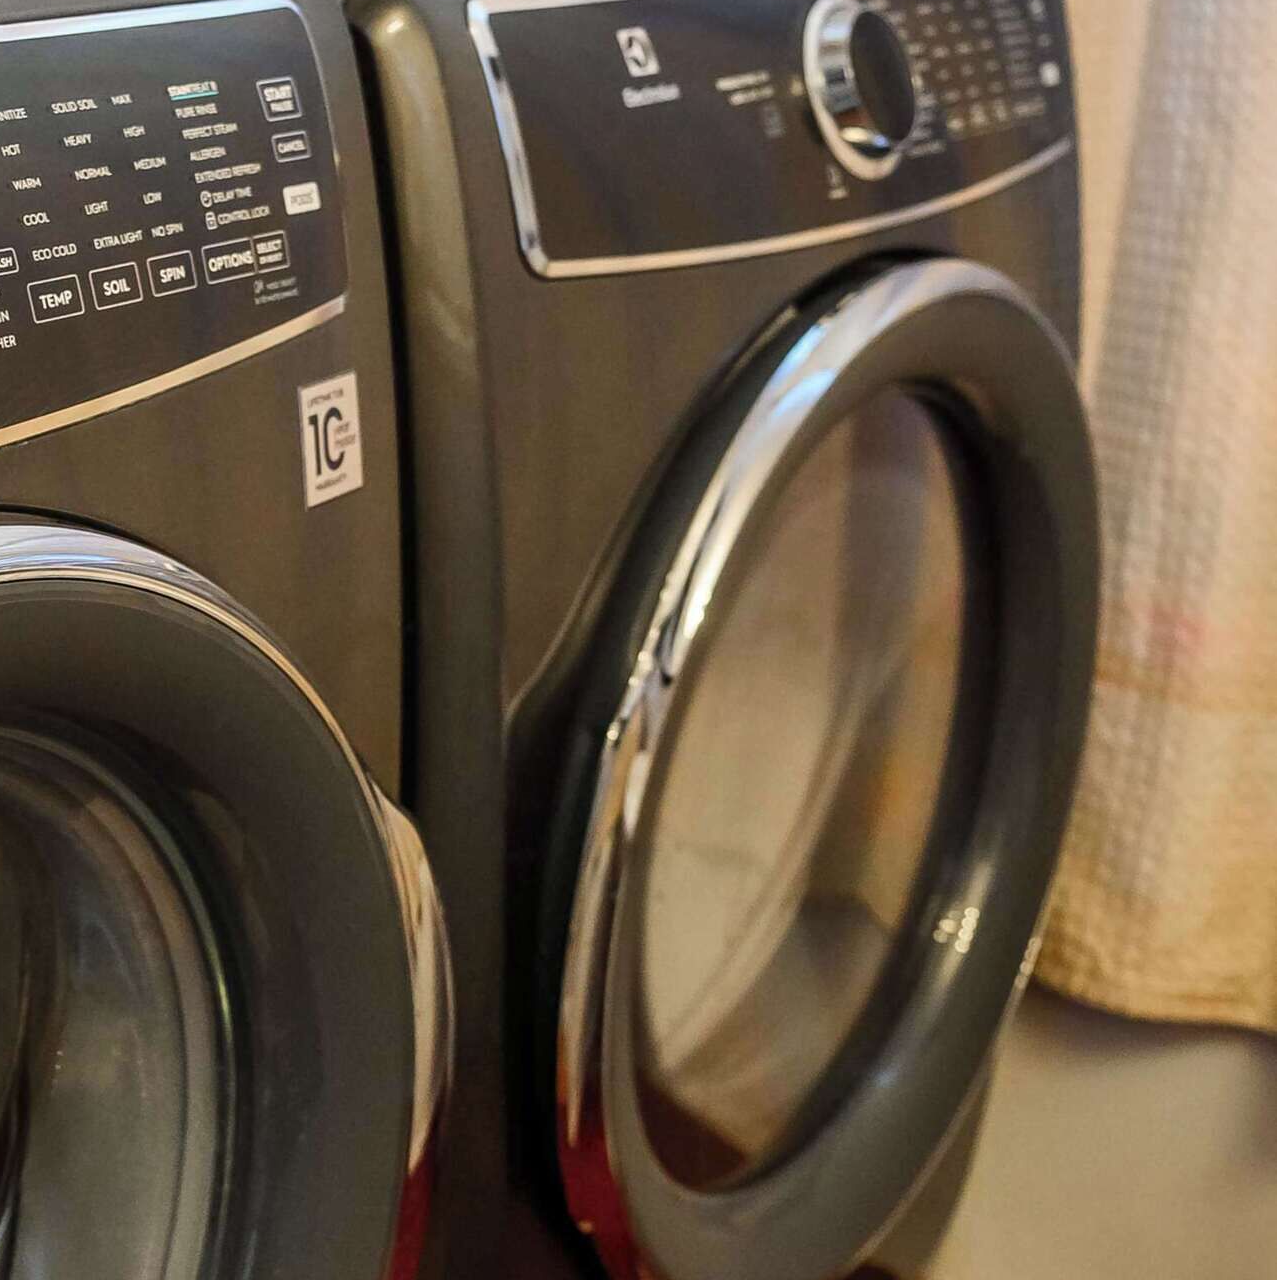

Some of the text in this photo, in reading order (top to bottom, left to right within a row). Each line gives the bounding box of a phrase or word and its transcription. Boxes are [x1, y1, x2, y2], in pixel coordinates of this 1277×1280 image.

[51, 99, 98, 114] SOLID SOIL
[123, 125, 146, 138] HIGH
[63, 133, 92, 147] HEAVY
[1, 144, 21, 156] HOT
[133, 157, 167, 170] MEDIUM
[74, 166, 113, 181] NORMAL
[12, 177, 42, 191] WARM
[143, 192, 162, 205] LOW
[84, 201, 108, 215] LIGHT
[23, 212, 50, 226] COOL
[151, 223, 184, 238] NO SPIN
[93, 230, 143, 250] EXTRA LIGHT
[32, 244, 77, 261] ECO COLD
[208, 251, 254, 272] OPTIONS
[159, 265, 186, 283] SPIN
[103, 278, 131, 296] SOIL
[39, 290, 73, 309] TEMP
